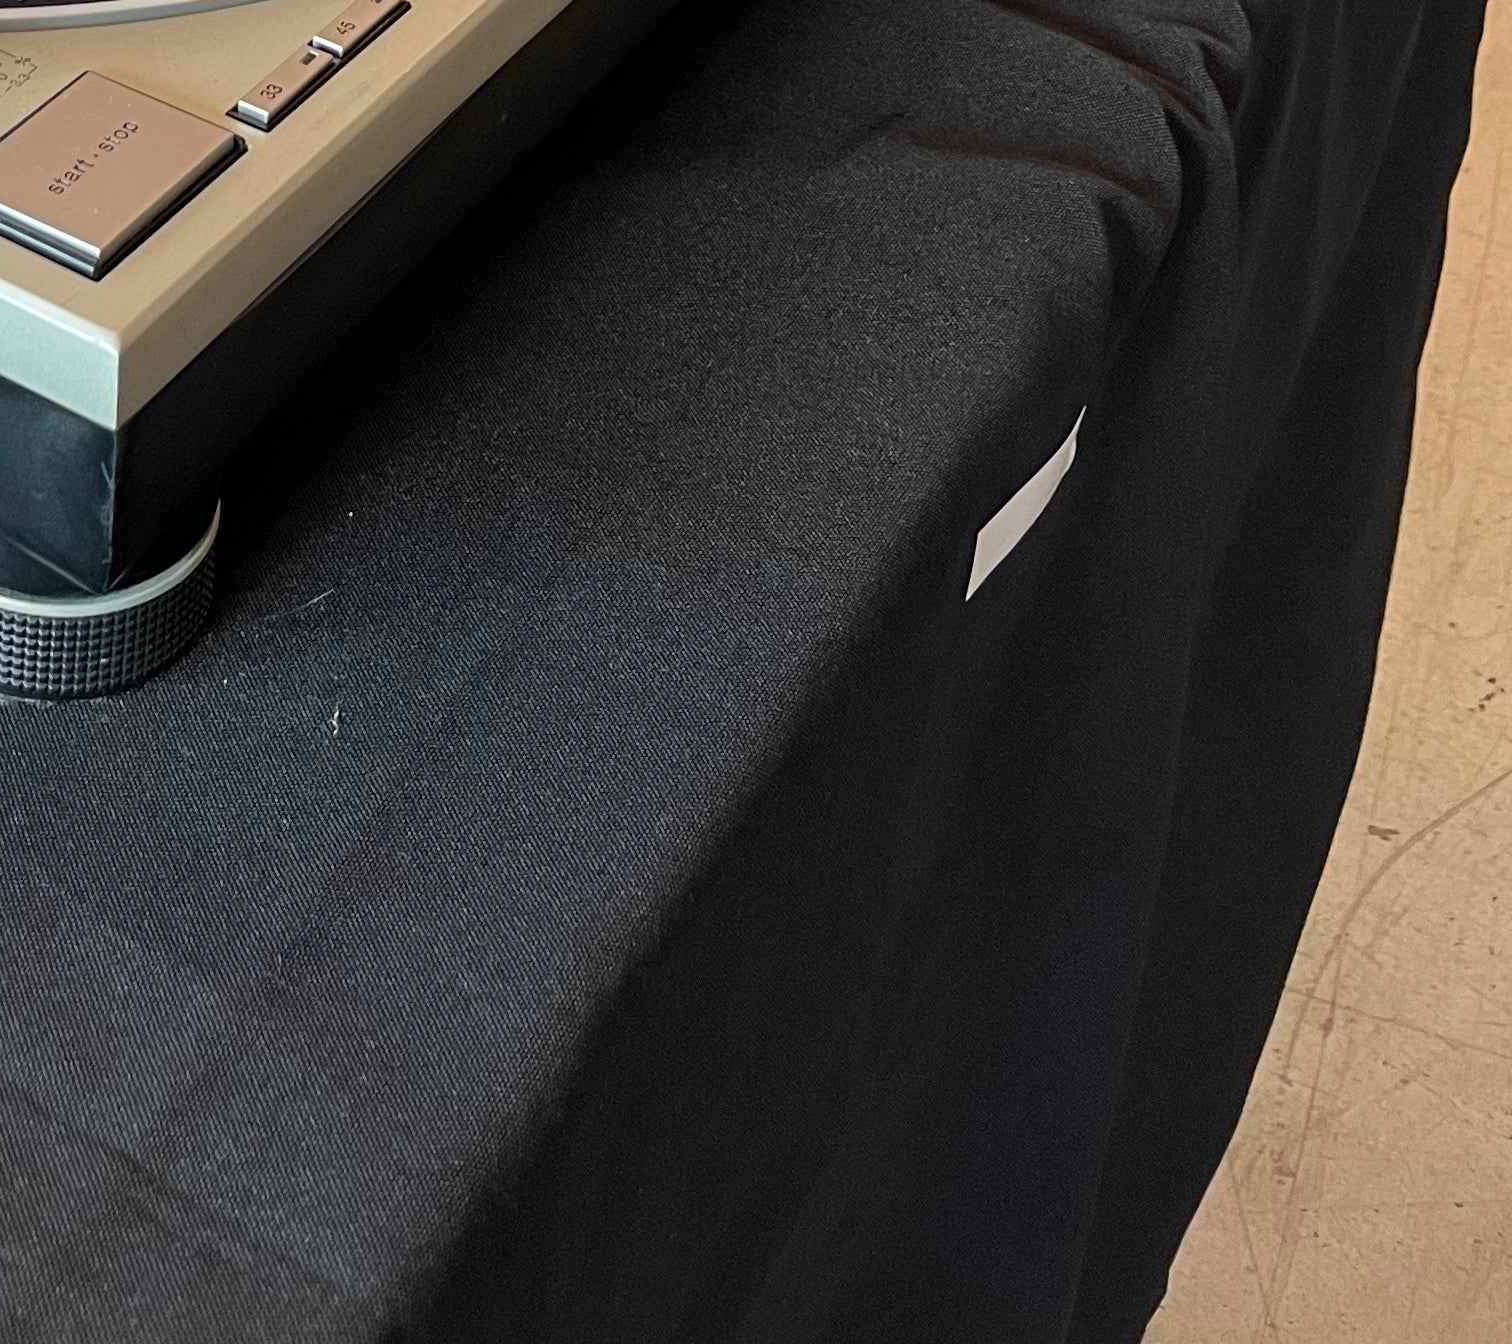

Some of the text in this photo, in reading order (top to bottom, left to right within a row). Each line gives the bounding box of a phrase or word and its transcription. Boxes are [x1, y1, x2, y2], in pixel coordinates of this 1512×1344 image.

[335, 20, 356, 35] 45
[259, 83, 283, 100] 33
[48, 121, 139, 194] start stop
